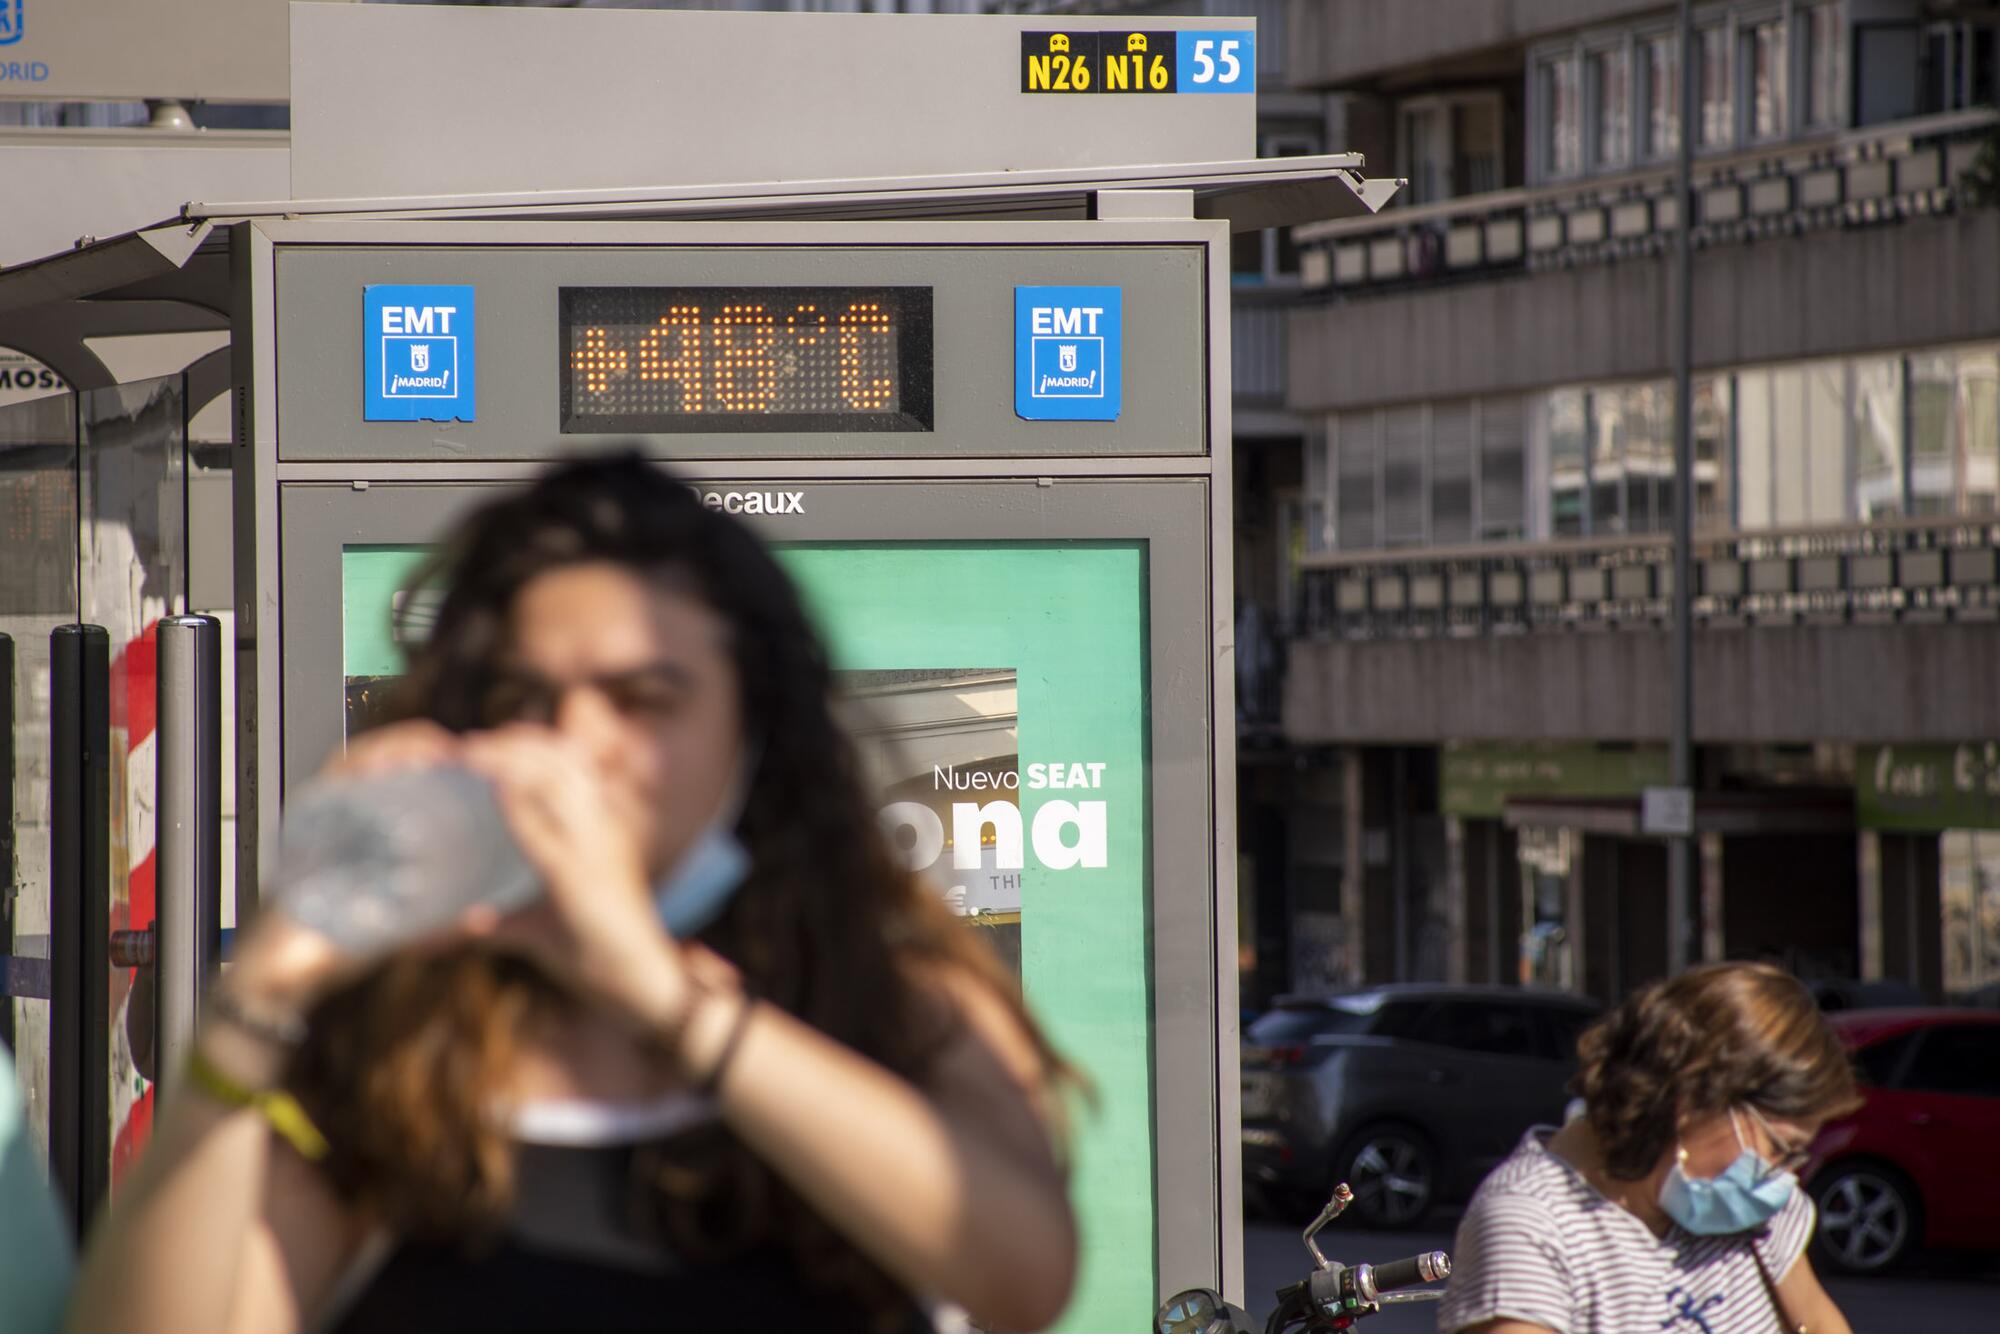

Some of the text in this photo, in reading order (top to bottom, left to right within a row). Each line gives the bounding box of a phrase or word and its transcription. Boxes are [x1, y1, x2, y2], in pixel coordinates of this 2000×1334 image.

[1029, 40, 1240, 90] N26 N16 55
[382, 306, 456, 334] EMT
[1032, 307, 1103, 334] EMT
[690, 487, 805, 514] ecaux
[934, 763, 1106, 790] Nuevo SEAT
